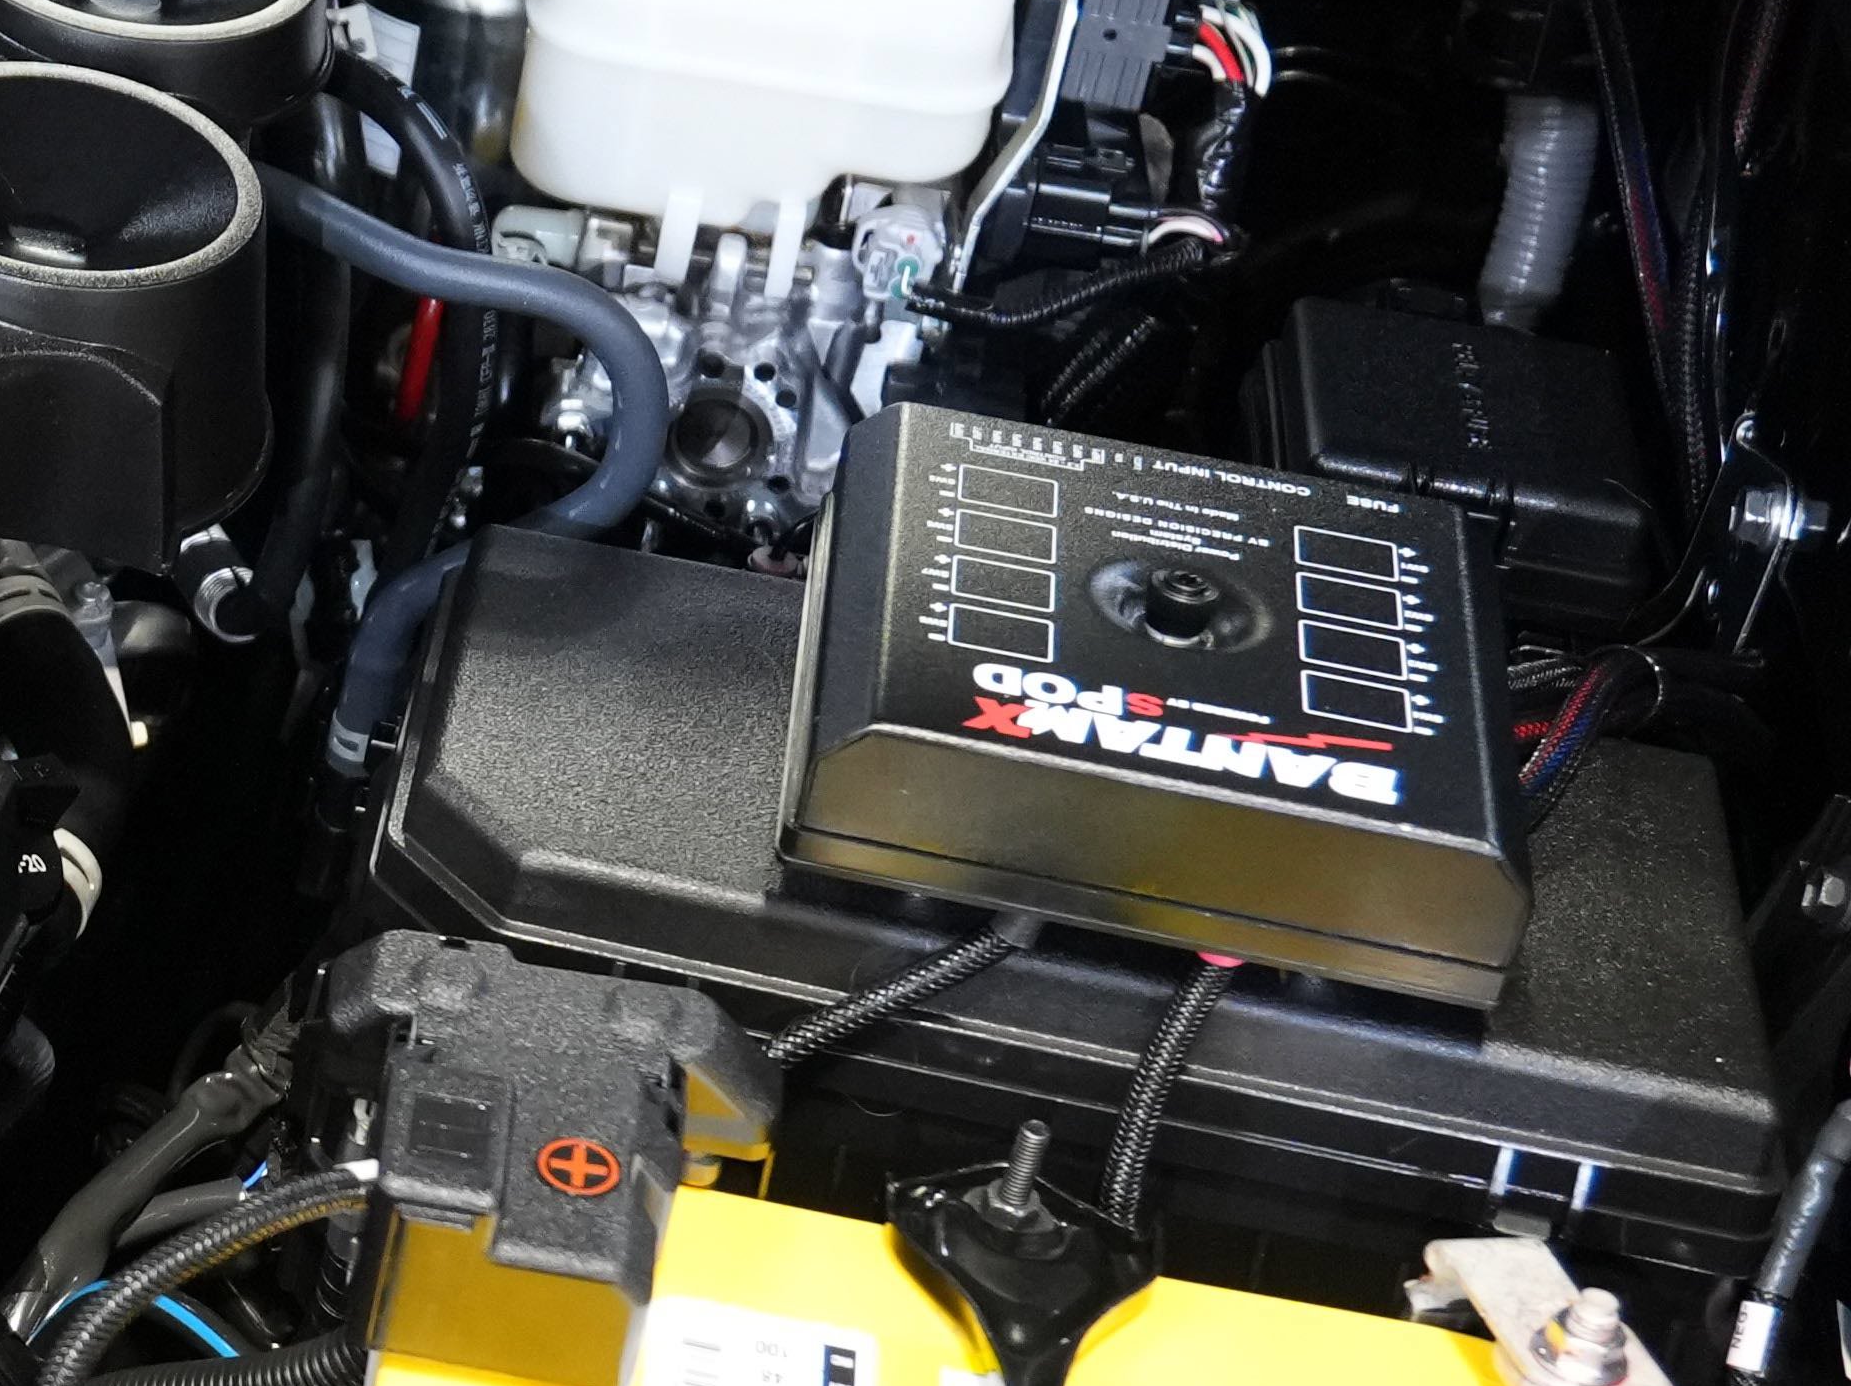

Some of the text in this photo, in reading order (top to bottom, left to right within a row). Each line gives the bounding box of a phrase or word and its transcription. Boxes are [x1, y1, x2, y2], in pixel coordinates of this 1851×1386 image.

[1152, 460, 1312, 497] CONTROL INPUT
[1111, 490, 1154, 506] U.S.A.
[1156, 499, 1183, 511] The
[1346, 494, 1400, 514] FUSE
[1201, 506, 1240, 522] Made
[1084, 506, 1271, 548] BY PRECISION DESIGNS
[1149, 529, 1202, 545] System
[1111, 530, 1241, 561] Power Distribution
[18, 853, 47, 873] -20
